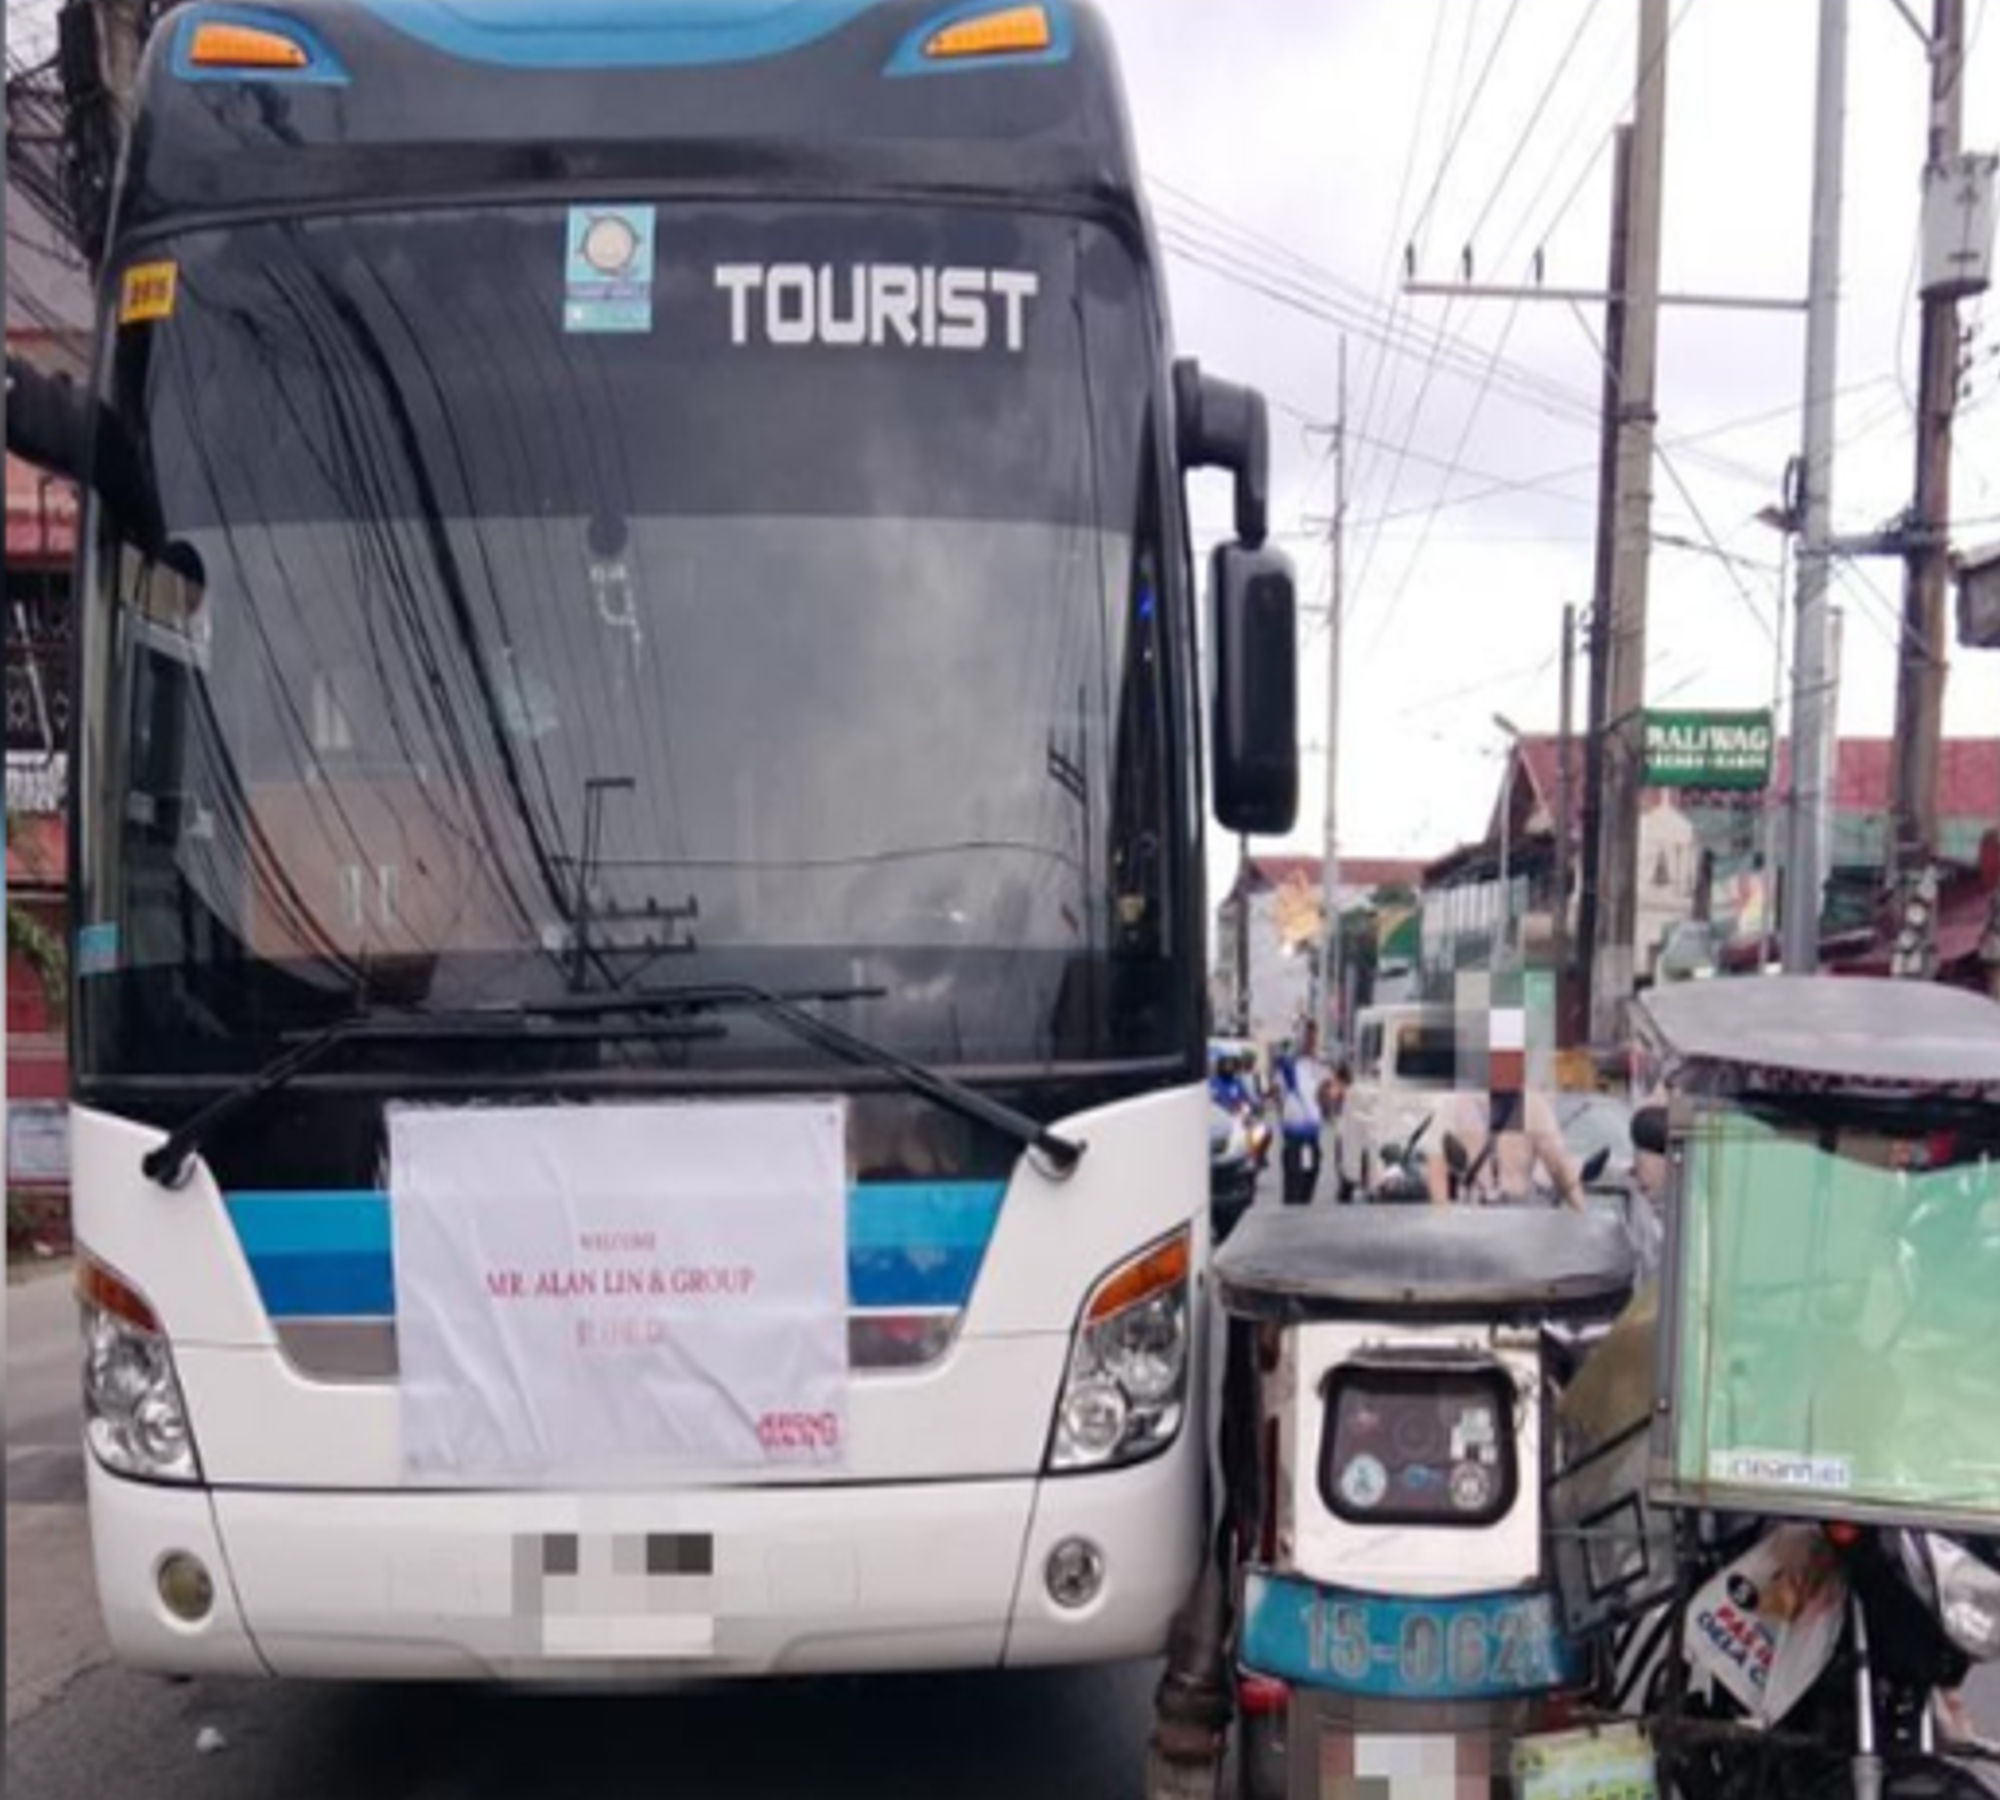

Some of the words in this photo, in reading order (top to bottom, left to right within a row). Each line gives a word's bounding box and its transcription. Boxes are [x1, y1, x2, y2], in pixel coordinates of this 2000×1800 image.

[713, 262, 1038, 350] TOURIST
[534, 1269, 597, 1296] ALAN
[603, 1267, 645, 1295] LIN
[650, 1267, 667, 1294] &
[670, 1264, 755, 1294] GROUP
